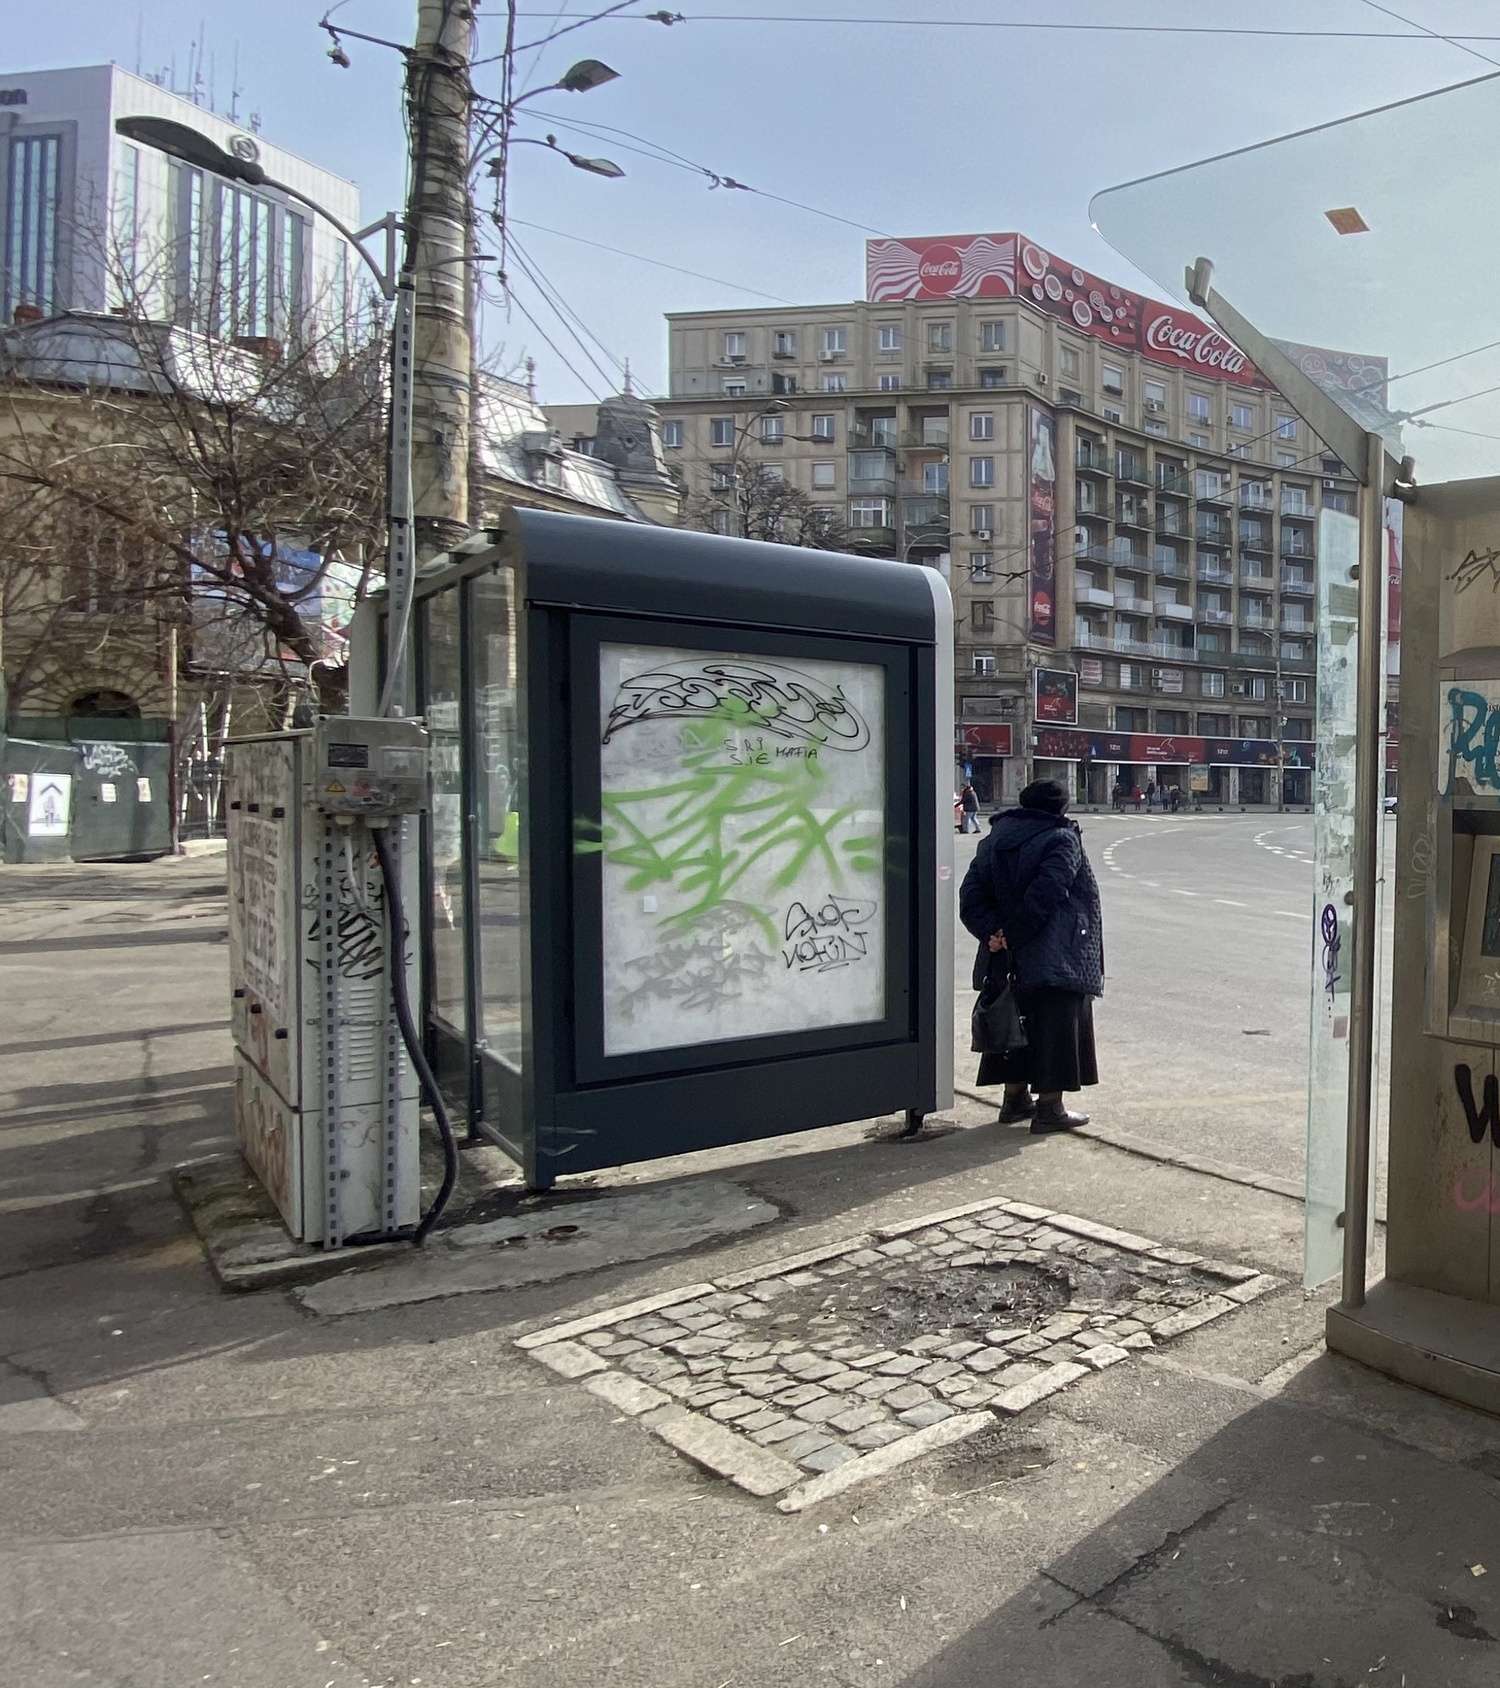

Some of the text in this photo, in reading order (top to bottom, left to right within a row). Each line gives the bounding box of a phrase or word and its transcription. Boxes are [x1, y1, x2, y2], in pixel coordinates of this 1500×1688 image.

[921, 261, 960, 277] Coca-Cola
[1146, 315, 1245, 374] Coca-Cola
[775, 745, 818, 760] MAFIA
